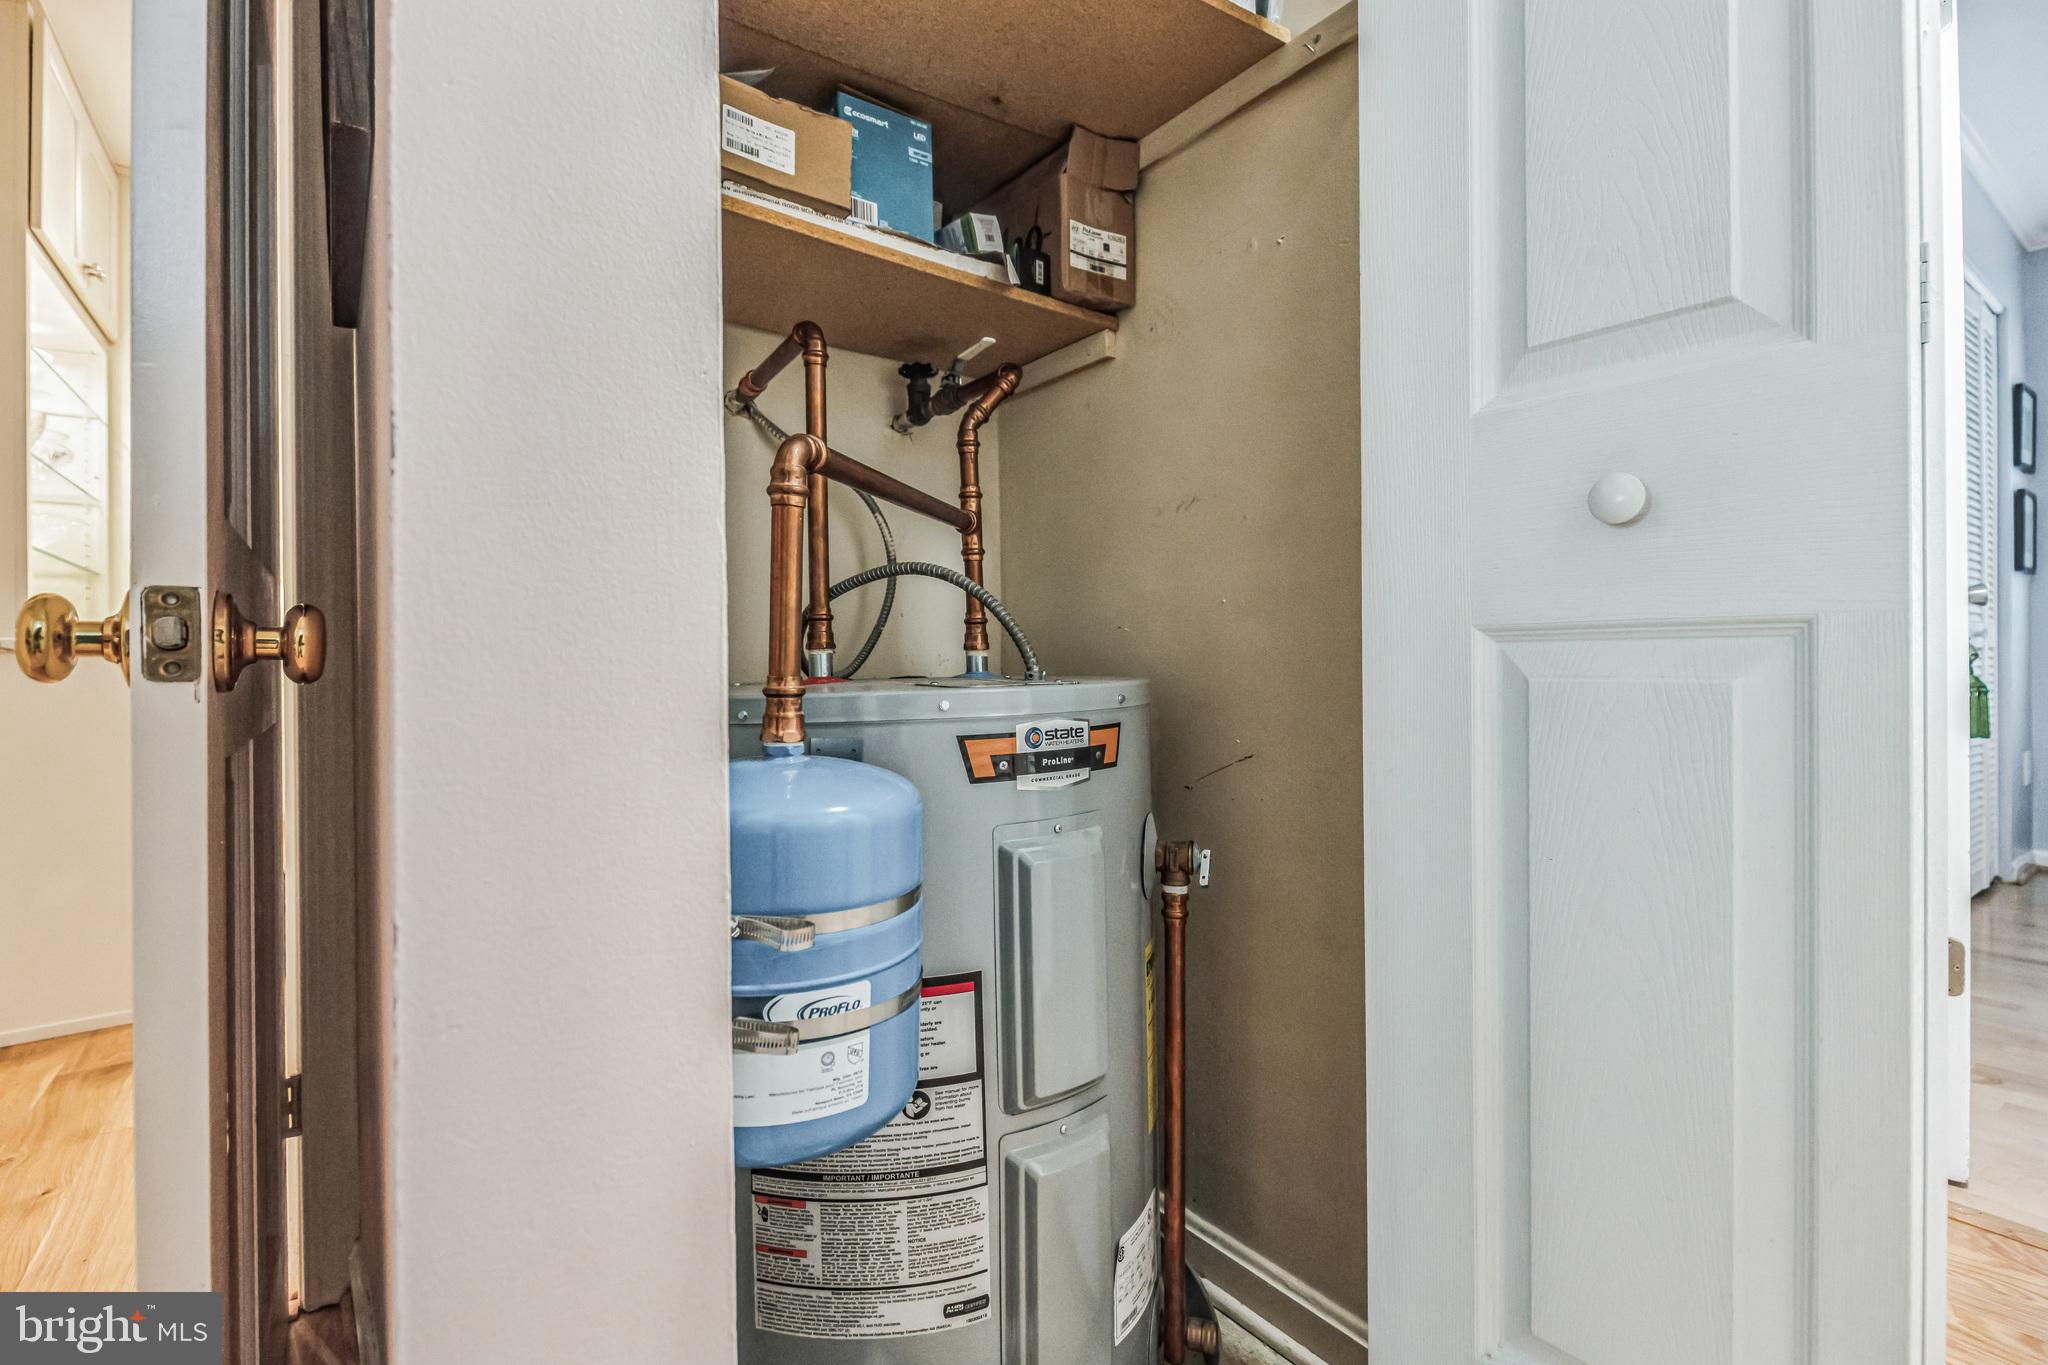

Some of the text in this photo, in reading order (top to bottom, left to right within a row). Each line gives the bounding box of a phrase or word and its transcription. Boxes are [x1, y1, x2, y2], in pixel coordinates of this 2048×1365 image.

[852, 111, 889, 128] ecosmart
[913, 132, 927, 142] LED
[1045, 727, 1084, 741] state
[808, 1000, 860, 1019] PROFLO
[872, 1171, 920, 1180] IMPORTANTE
